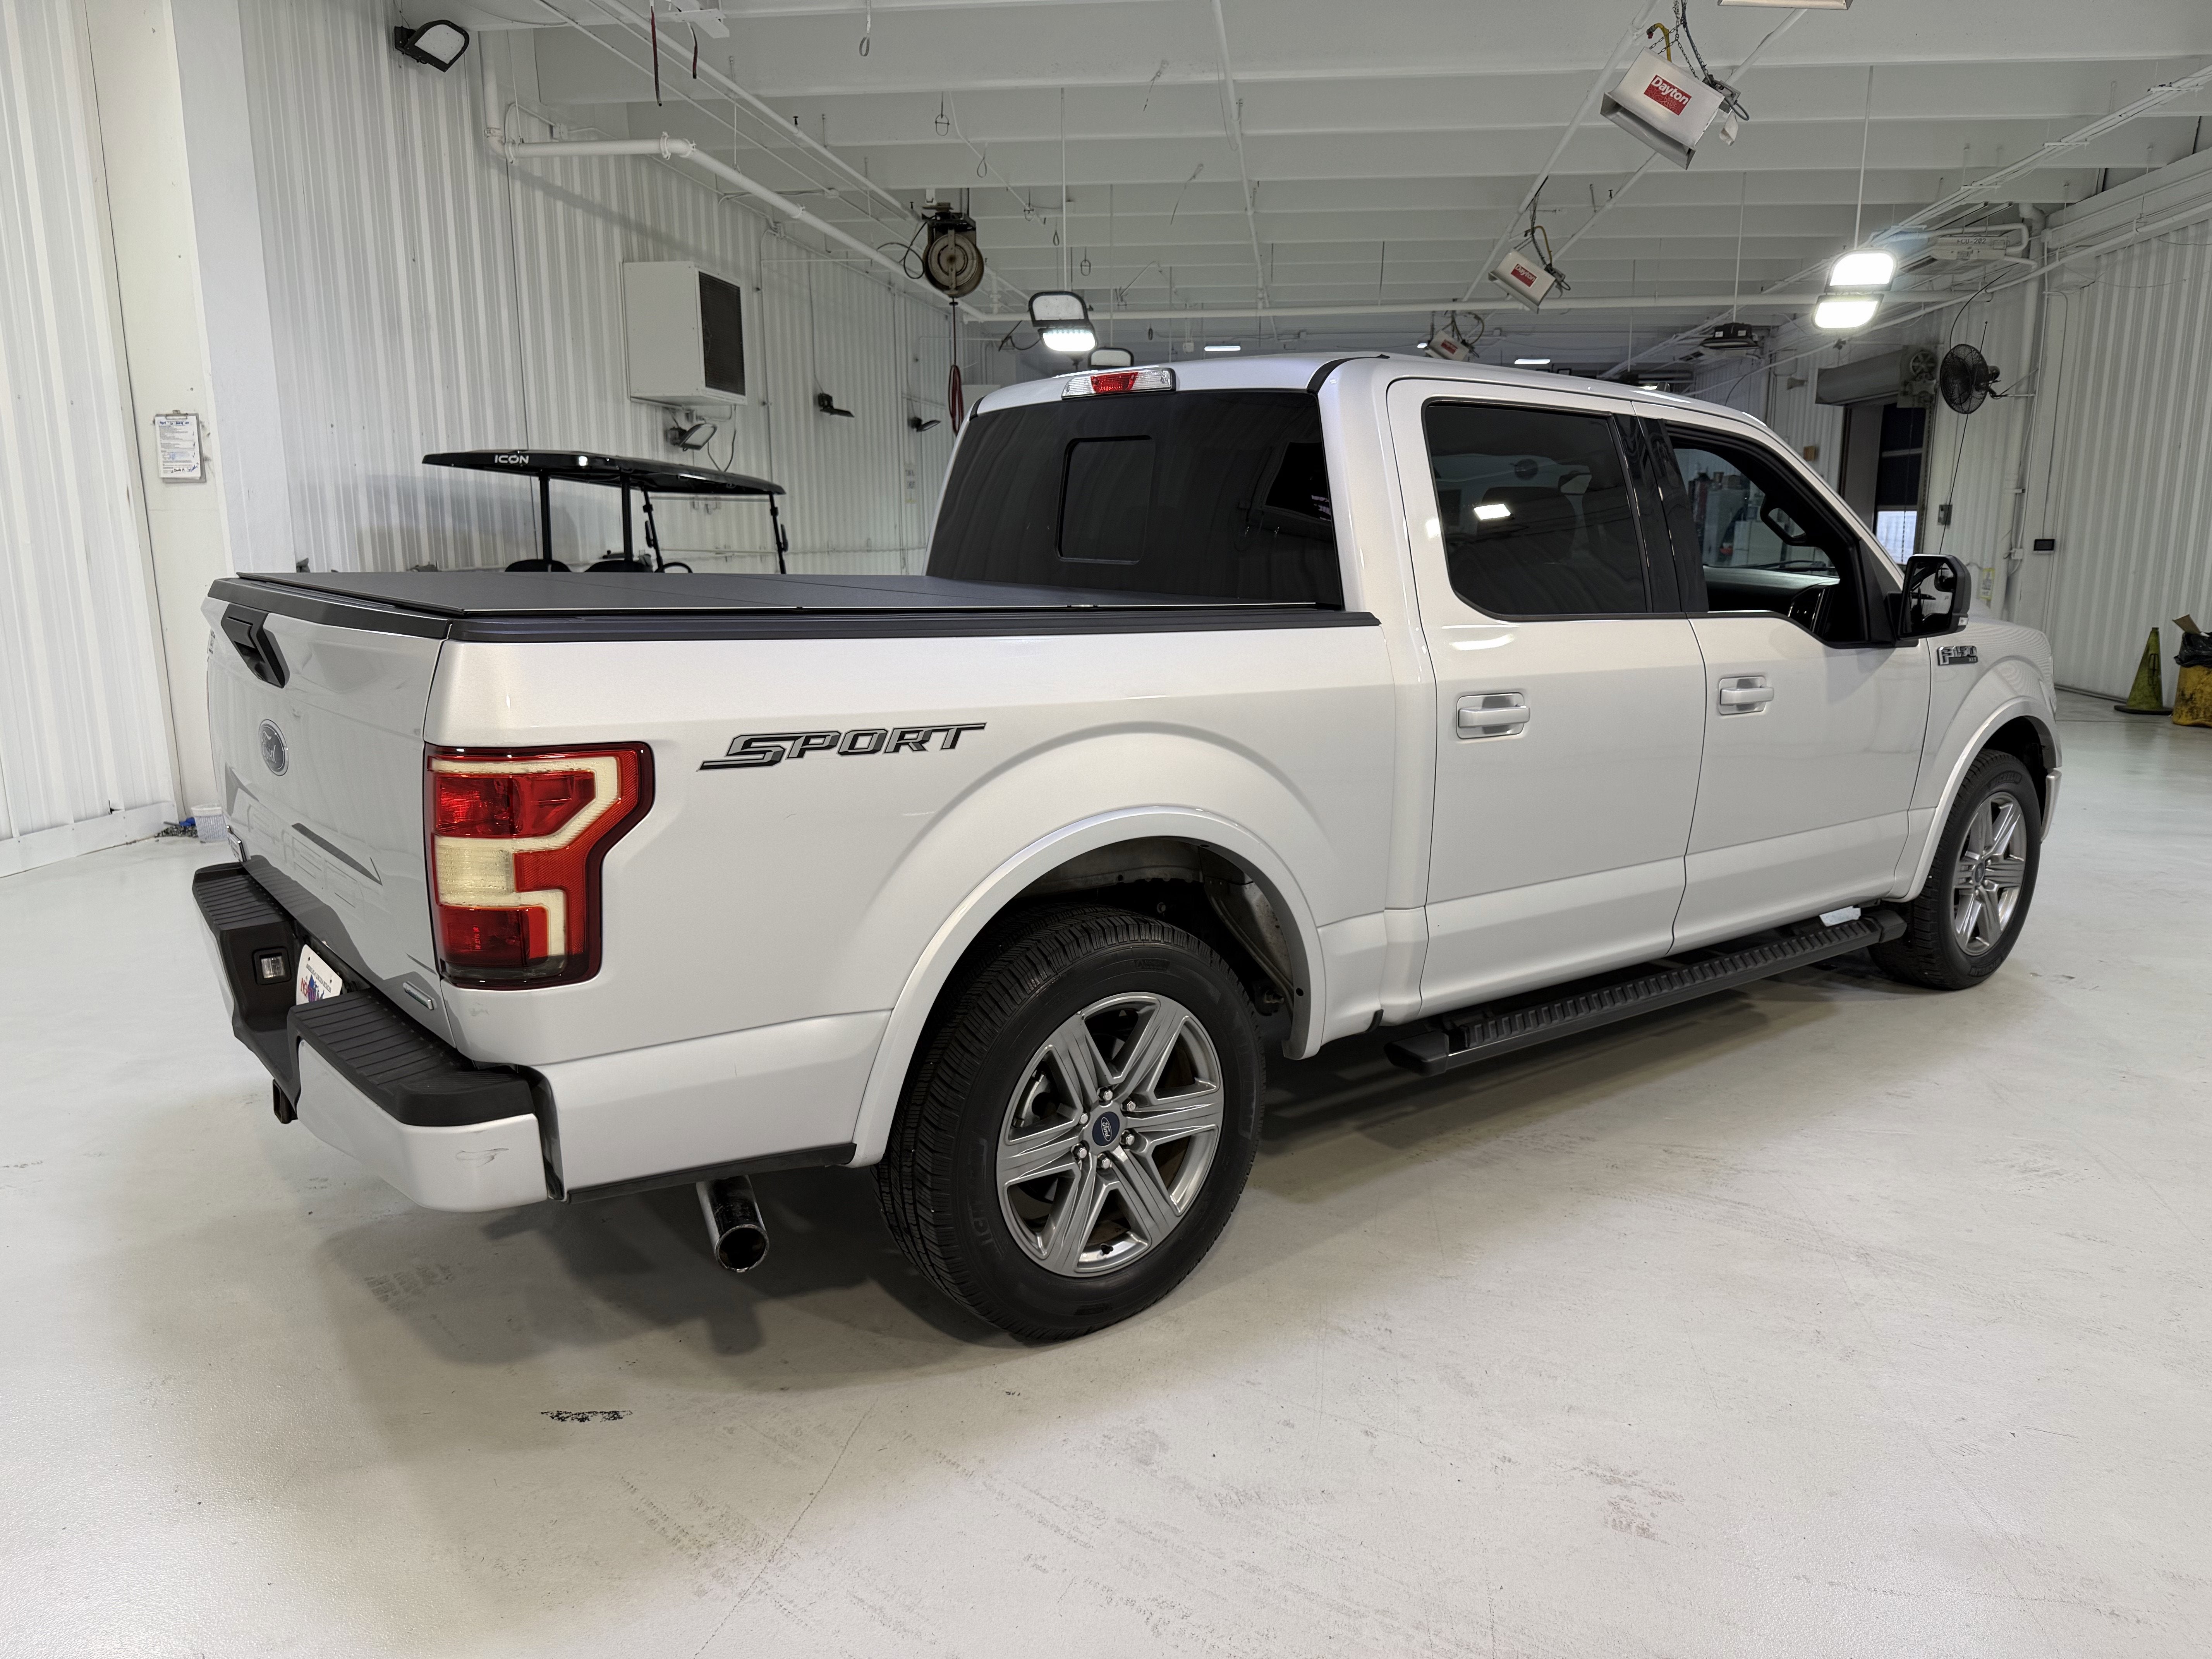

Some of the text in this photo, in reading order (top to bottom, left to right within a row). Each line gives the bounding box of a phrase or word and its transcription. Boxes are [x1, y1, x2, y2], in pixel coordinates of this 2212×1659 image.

[1651, 76, 1689, 105] Dayton
[1515, 265, 1535, 282] Dayton
[495, 455, 529, 464] ICON
[261, 730, 277, 764] Ford
[696, 722, 987, 772] SPORT
